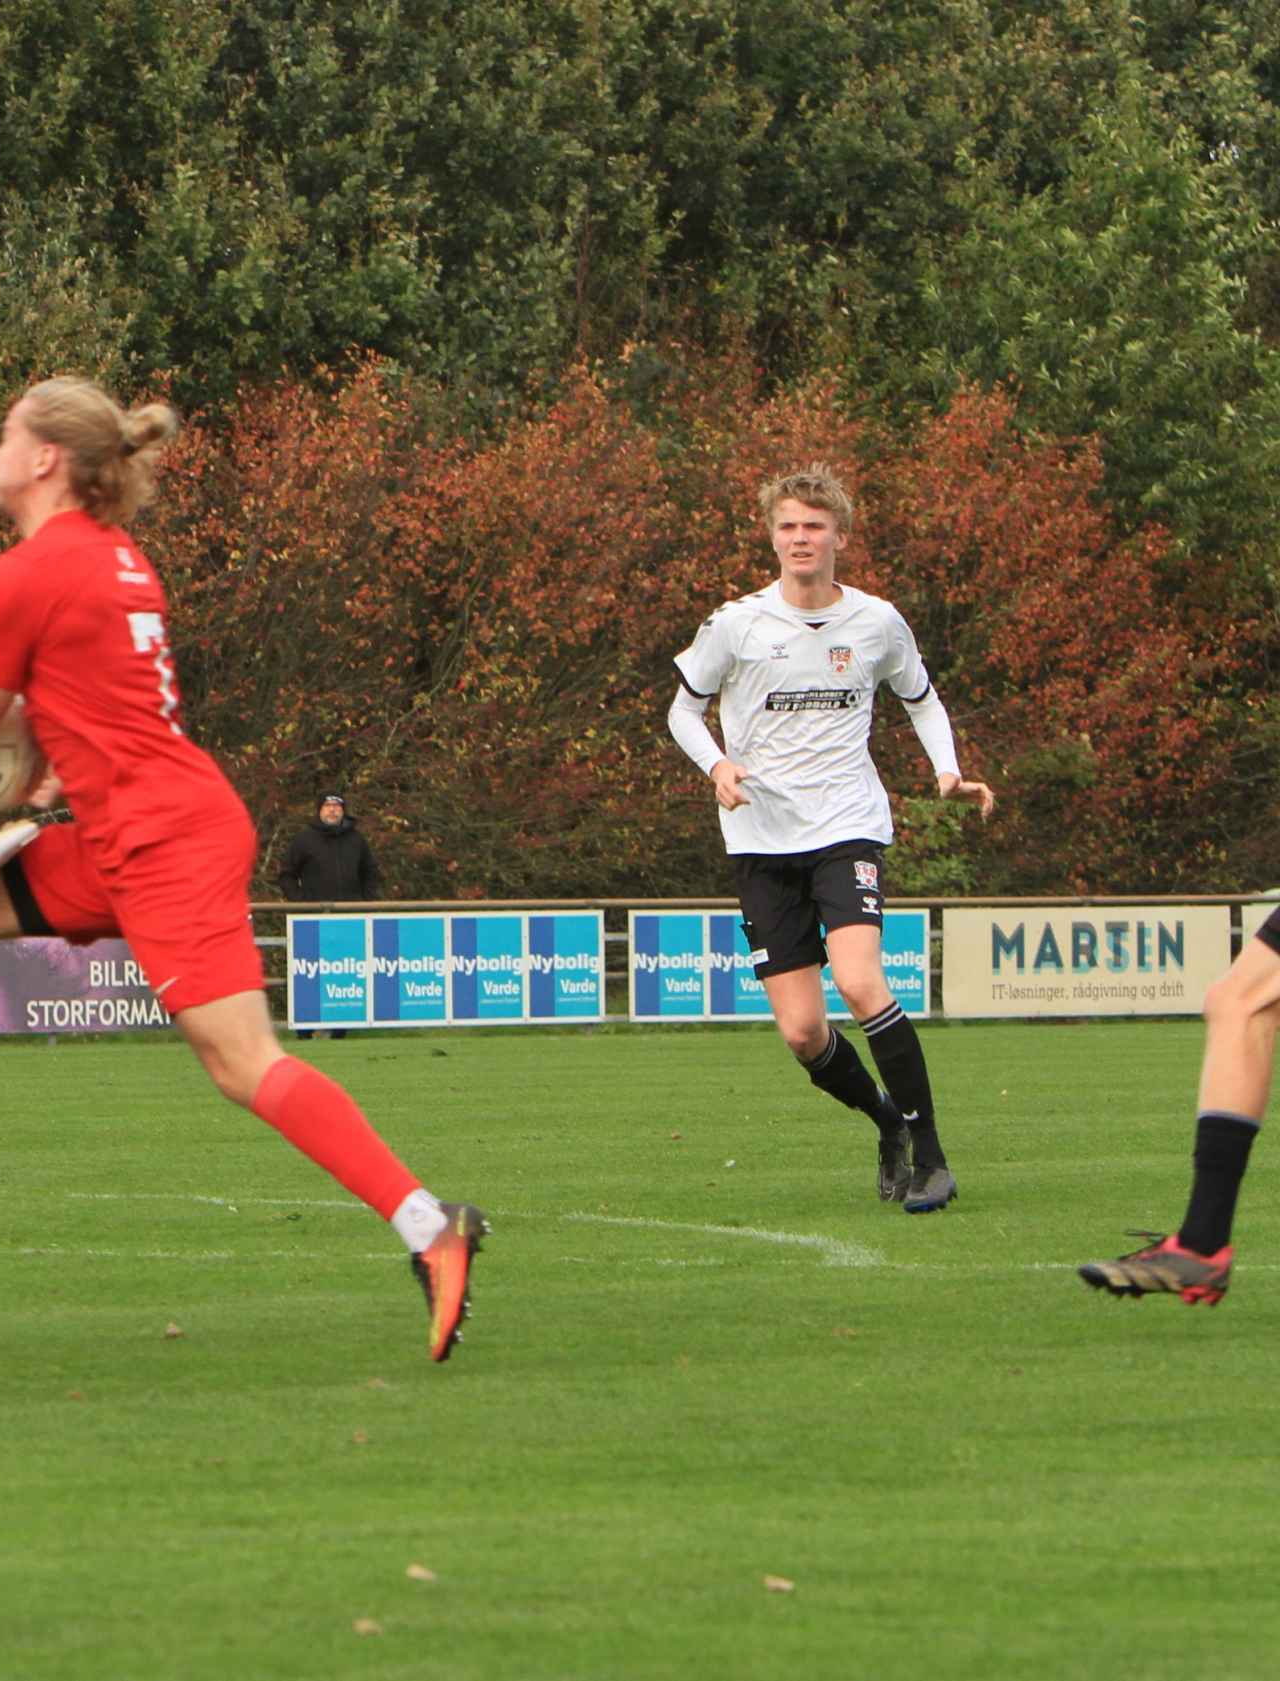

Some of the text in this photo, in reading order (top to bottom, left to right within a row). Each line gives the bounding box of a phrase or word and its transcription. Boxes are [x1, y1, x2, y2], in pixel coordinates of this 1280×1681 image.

[293, 957, 367, 979] Nybolig
[373, 955, 446, 977] Nybolig
[452, 954, 524, 975] Nybolig
[529, 953, 601, 974] Nybolig
[634, 952, 705, 973] Nybolig
[709, 952, 754, 972] Nybo
[881, 950, 926, 972] bolig
[326, 983, 363, 998] Varde
[405, 981, 443, 997] Varde
[483, 979, 520, 995] Varde
[560, 978, 597, 993] Varde
[665, 977, 701, 992] Varde
[740, 977, 766, 992] Var
[887, 975, 922, 990] Varde
[1073, 981, 1137, 1001] rådgivning
[1141, 985, 1156, 1000] og
[1160, 980, 1185, 998] drift
